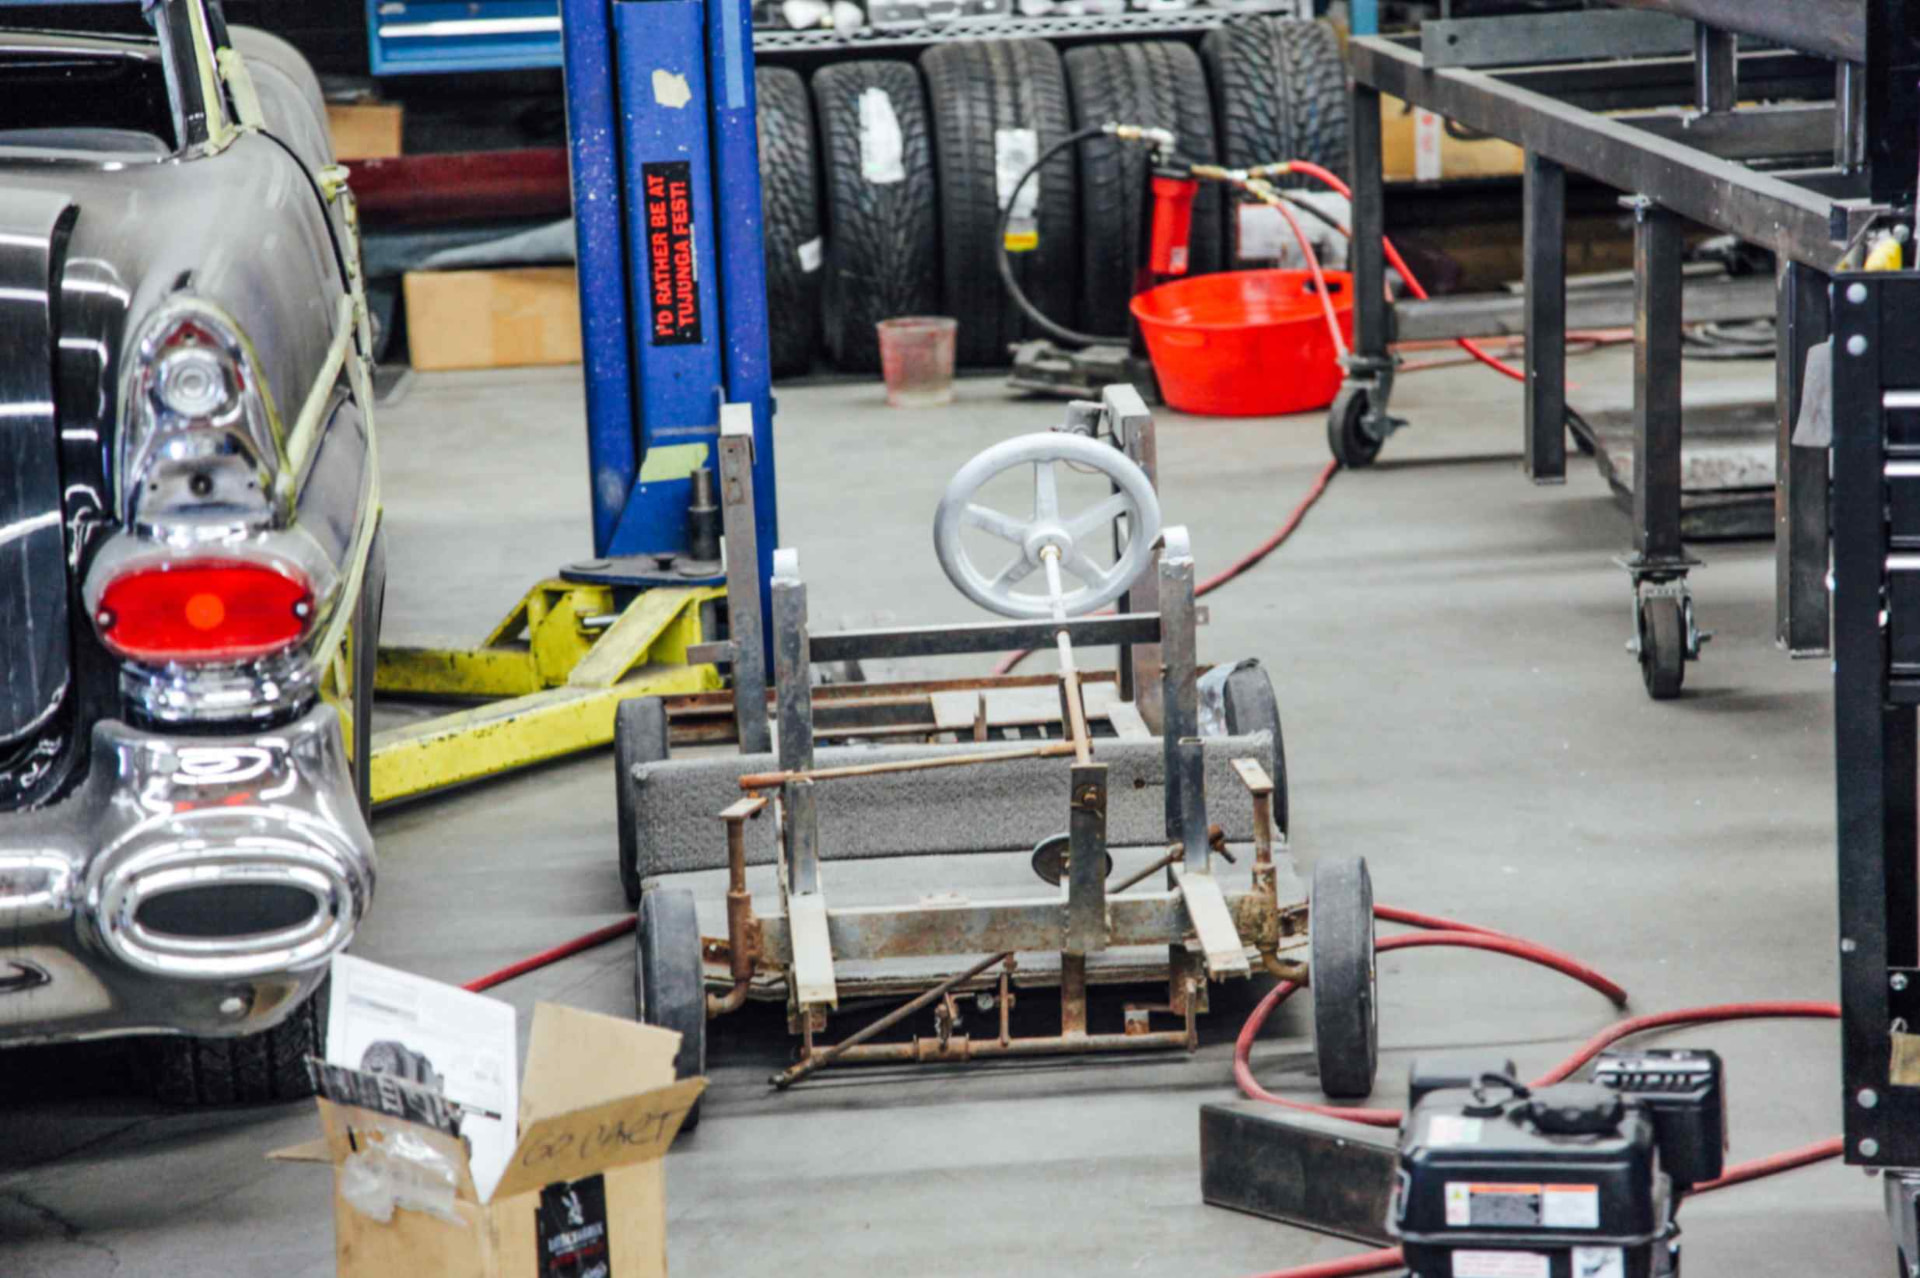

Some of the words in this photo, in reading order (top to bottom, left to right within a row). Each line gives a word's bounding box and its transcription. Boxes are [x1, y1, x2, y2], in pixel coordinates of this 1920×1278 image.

[647, 175, 664, 197] AT
[650, 202, 667, 227] BE
[669, 182, 688, 235] FEST!
[652, 232, 672, 305] RATHER
[674, 240, 695, 327] TUJUNGA
[657, 311, 674, 335] I'D
